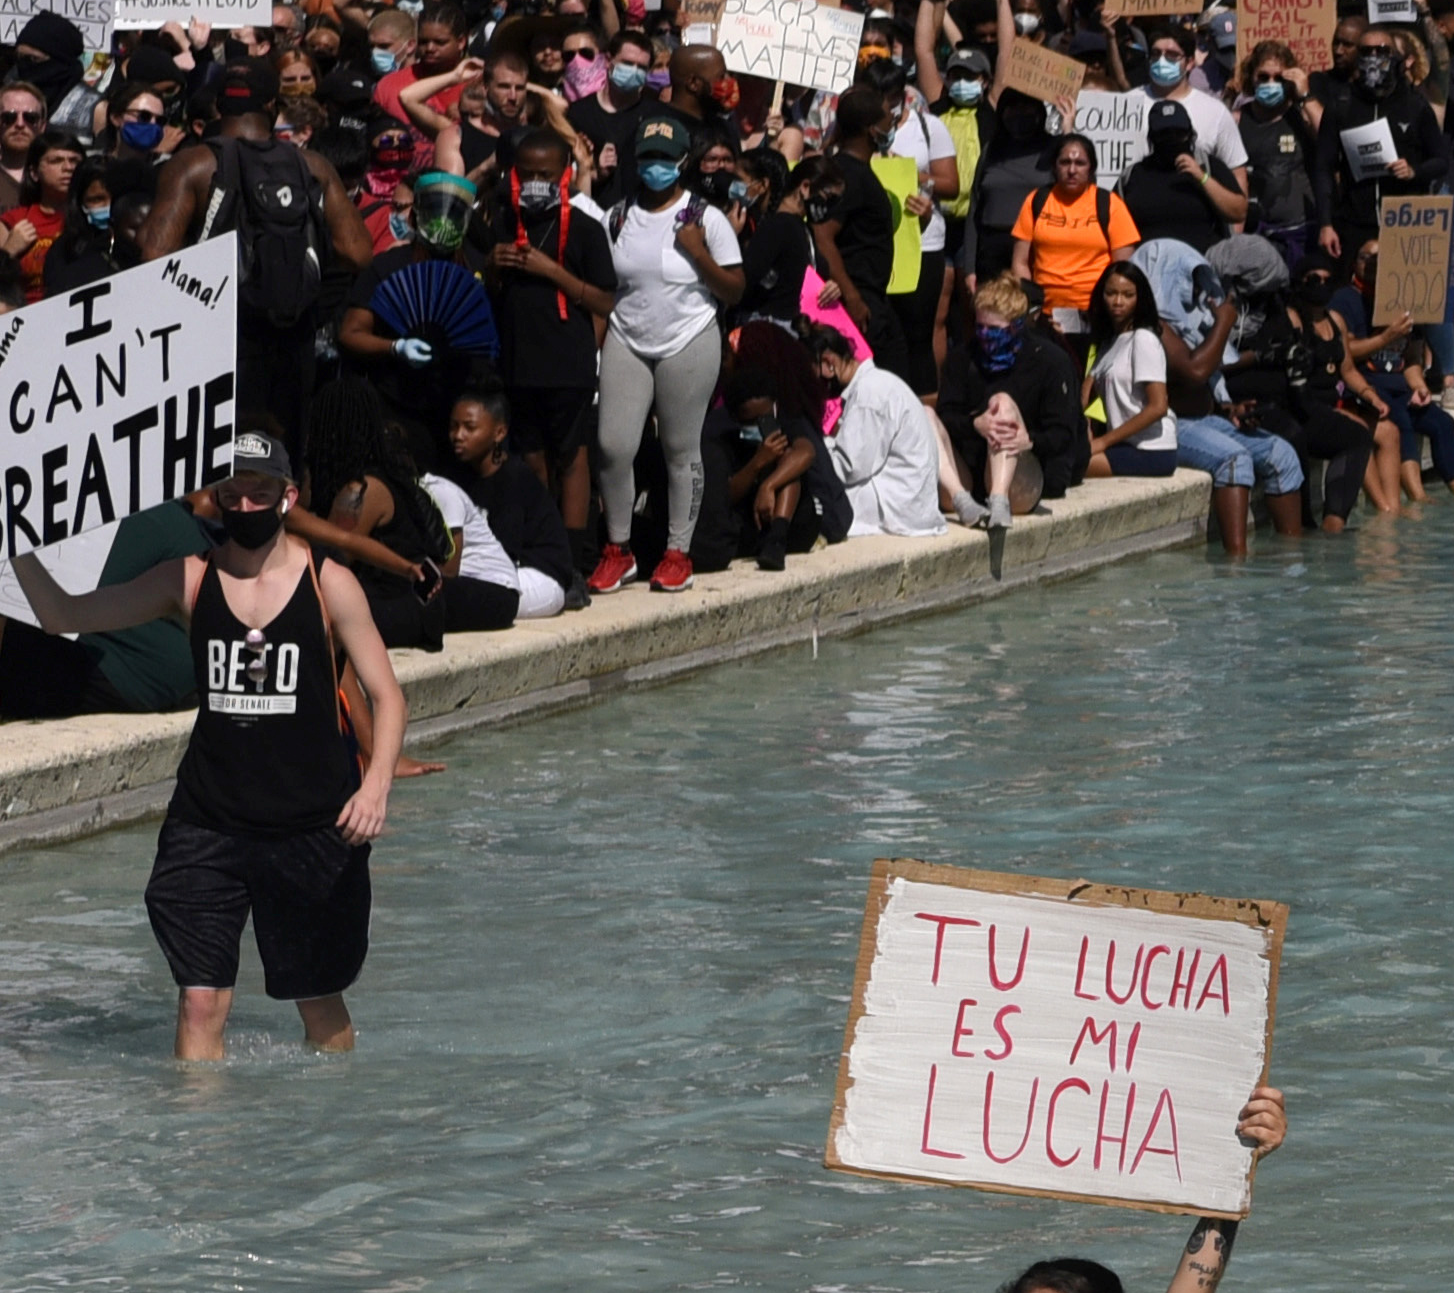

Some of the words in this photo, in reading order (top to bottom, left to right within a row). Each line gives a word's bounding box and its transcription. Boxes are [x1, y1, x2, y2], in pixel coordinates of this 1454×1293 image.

[1244, 26, 1290, 39] THOSE
[1300, 25, 1316, 36] IT
[1258, 11, 1307, 26] FAIL
[1400, 233, 1444, 266] VOTE
[65, 281, 112, 347] I
[161, 258, 230, 310] Mama!
[8, 322, 182, 435] CAN'T
[0, 370, 236, 559] REATHE
[240, 698, 271, 712] SENATE
[914, 912, 1030, 992] TU
[1073, 933, 1231, 1016] LUCHA
[950, 998, 1022, 1061] ES
[1068, 1016, 1142, 1073] MI
[920, 1063, 1183, 1184] LUCHA
